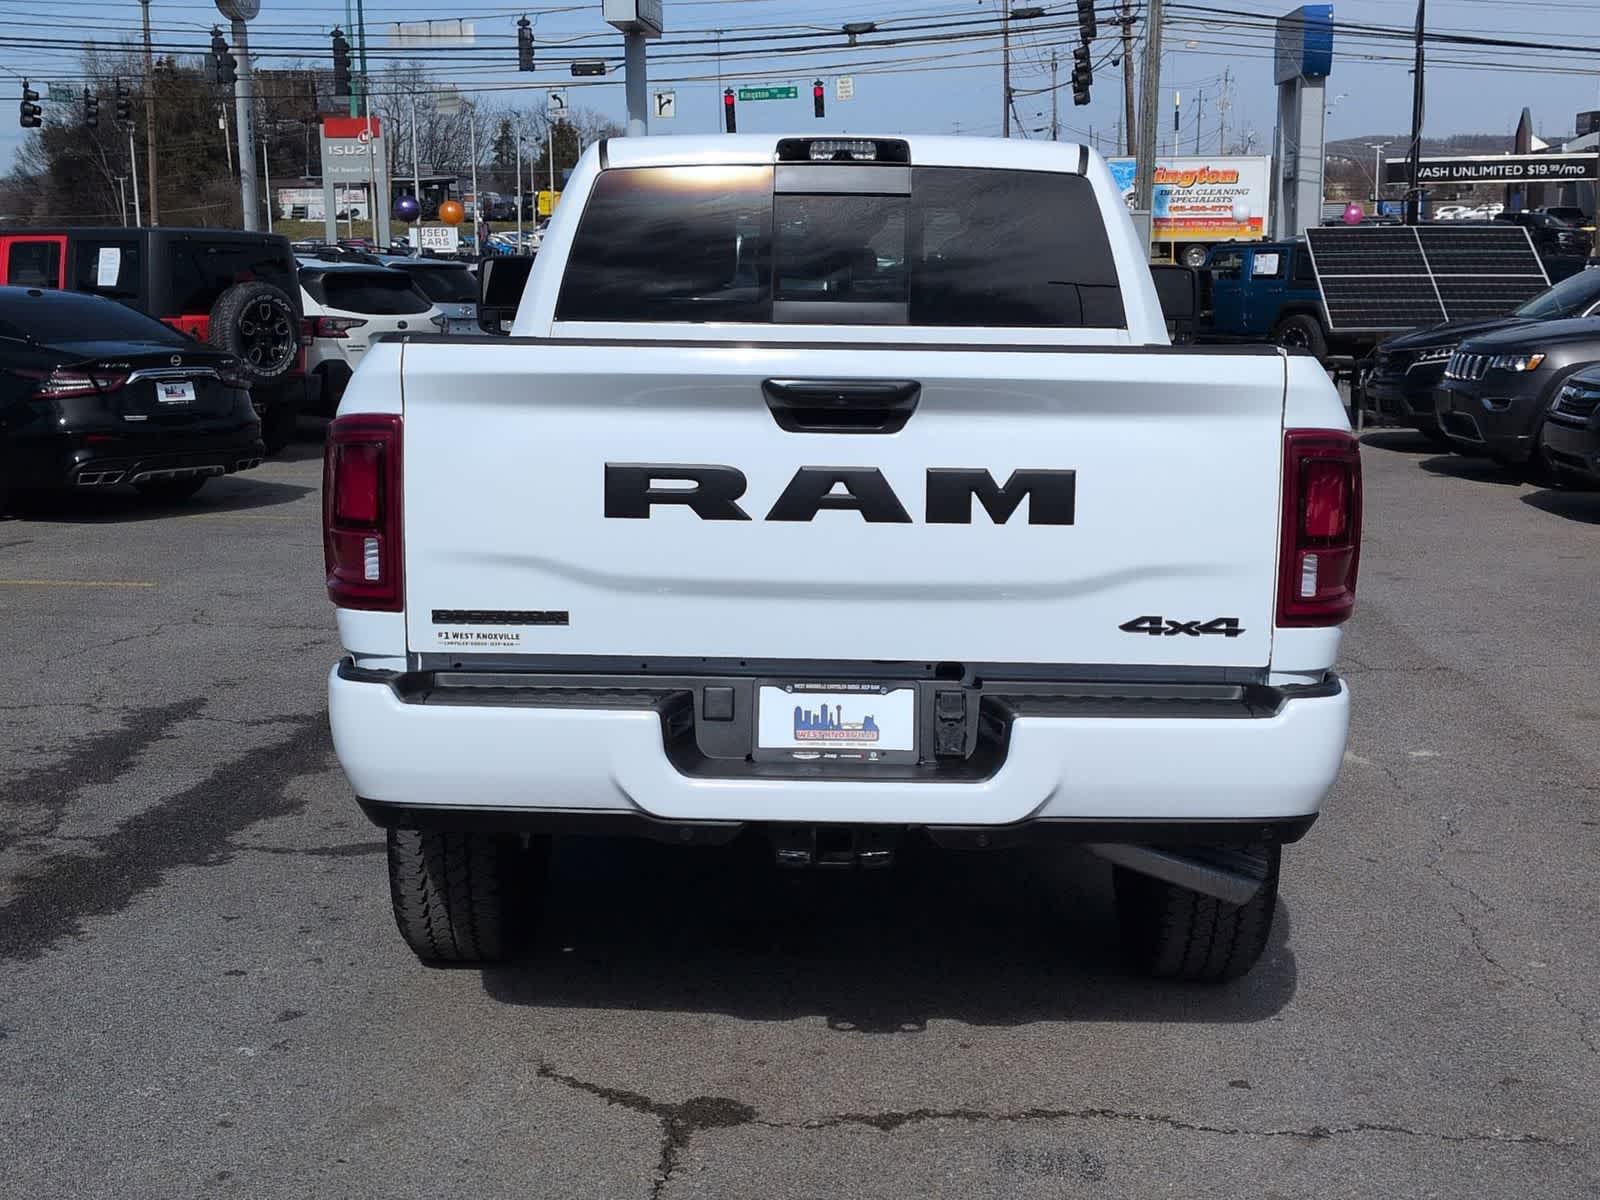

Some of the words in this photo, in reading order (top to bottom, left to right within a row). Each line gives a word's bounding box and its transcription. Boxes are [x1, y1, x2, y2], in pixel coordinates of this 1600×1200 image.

[740, 91, 769, 100] Kingston
[328, 145, 377, 155] ISUZU
[1153, 166, 1239, 188] ington
[1453, 164, 1523, 178] UNLIMITED
[1196, 188, 1249, 196] CLEANING
[604, 462, 1077, 526] RAM
[1118, 615, 1247, 638] 4x4
[438, 631, 450, 640] #1
[452, 632, 474, 640] WEST
[476, 632, 520, 641] KNOXVILLE
